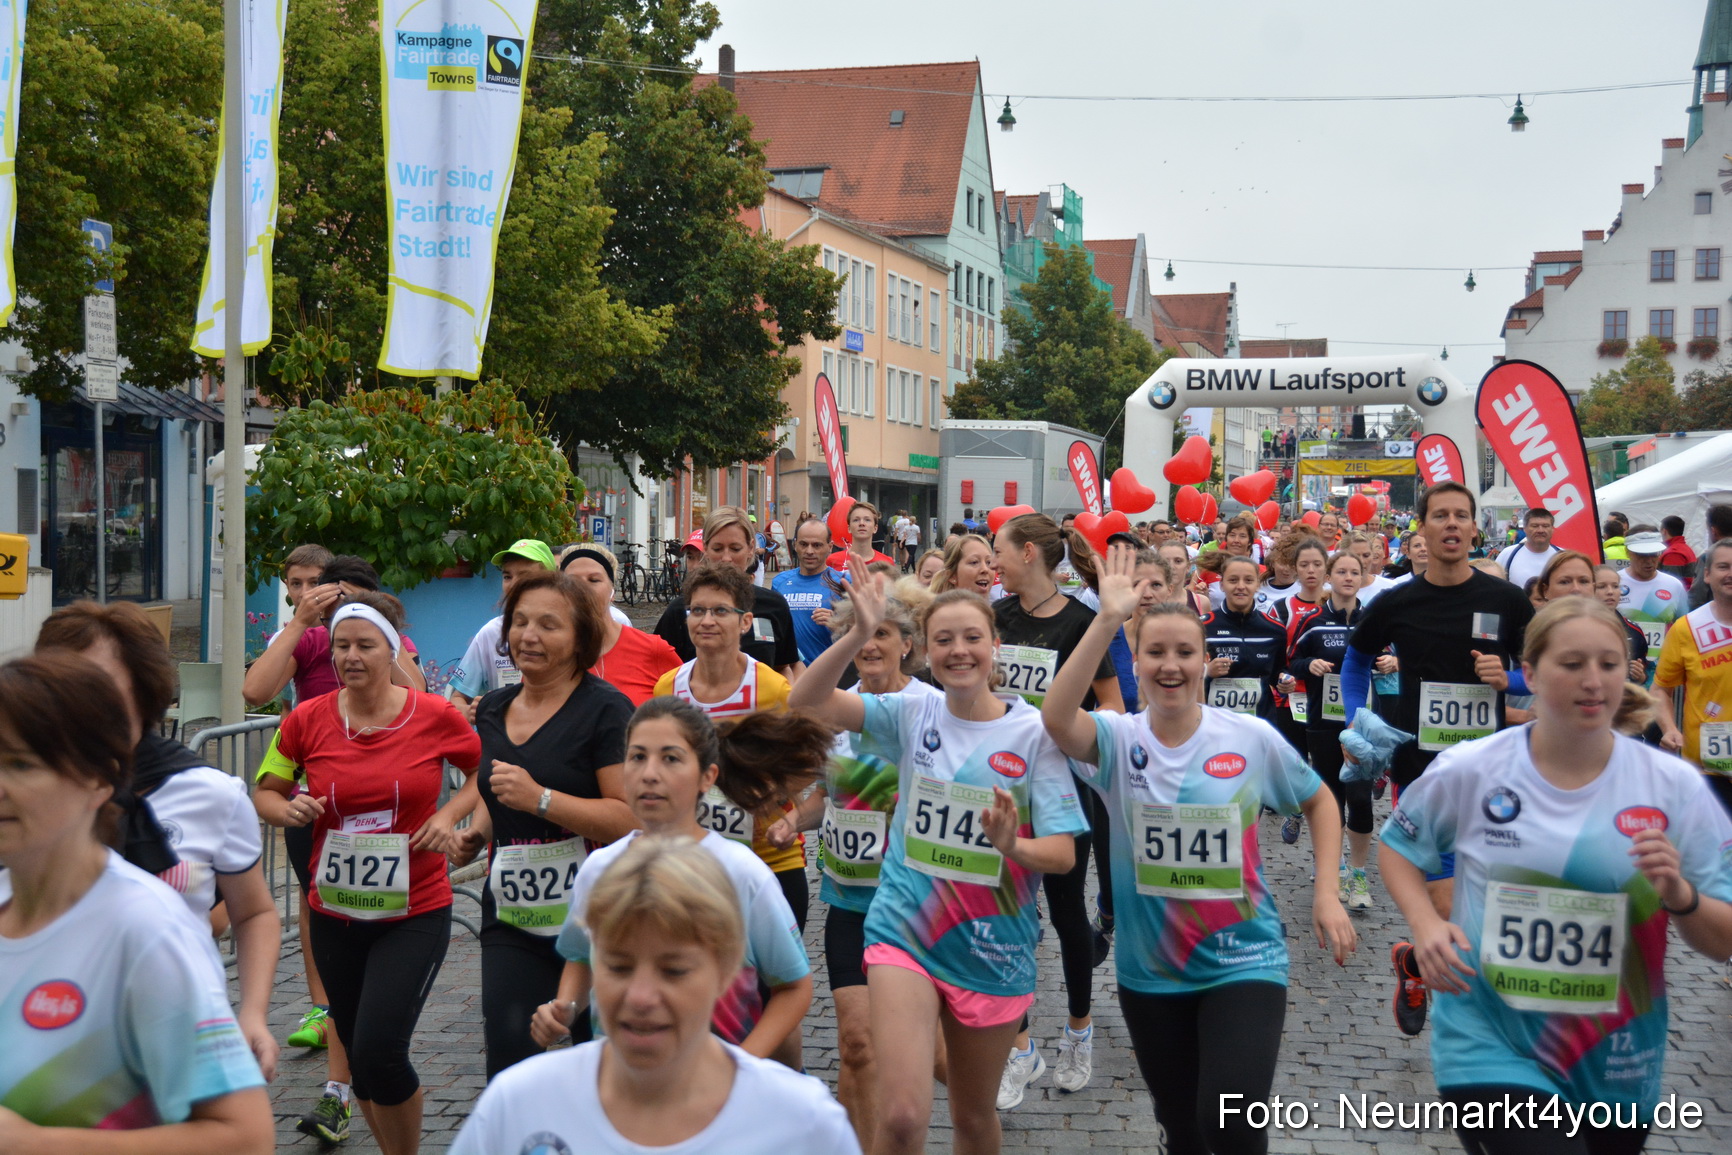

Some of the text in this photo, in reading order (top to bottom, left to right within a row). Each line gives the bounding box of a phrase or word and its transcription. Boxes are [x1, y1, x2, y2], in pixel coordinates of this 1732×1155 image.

[397, 32, 473, 48] Kampagne
[398, 47, 481, 66] Fairtrade
[429, 71, 475, 85] Towns
[487, 74, 520, 86] FAIRTRADE
[396, 162, 494, 192] Wir sind
[395, 198, 497, 228] Fairtrade
[398, 233, 471, 259] Stadt!
[90, 321, 113, 332] werktags
[1186, 367, 1406, 394] BMW Laufsport
[1491, 383, 1585, 529] REWE
[1344, 462, 1371, 472] ZIEL
[1422, 443, 1452, 488] WE
[1072, 451, 1101, 517] REWE
[594, 520, 603, 534] P
[1324, 638, 1345, 648] Götz
[1647, 632, 1660, 646] 12
[1018, 648, 1049, 662] BOCK
[997, 661, 1047, 693] 5272
[1214, 689, 1258, 709] 5044
[1456, 686, 1492, 697] BOCK
[1427, 699, 1490, 726] 5010
[1437, 730, 1478, 743] Andreas
[1707, 735, 1732, 756] 51
[993, 754, 1024, 773] Hervis
[1208, 758, 1243, 772] Hervis
[697, 801, 745, 835] 252
[836, 811, 879, 826] BOCK
[1140, 812, 1174, 821] NeuerMarkt
[1179, 807, 1231, 819] BOCK
[354, 816, 378, 828] DEHN
[1619, 814, 1664, 830] Hervis
[354, 836, 401, 848] BOCK
[825, 820, 877, 862] 5192
[1484, 828, 1521, 841] PARTL
[528, 842, 577, 860] BOCK
[1144, 825, 1228, 864] 5141
[931, 847, 964, 868] Lena
[325, 851, 401, 887] 5127
[835, 861, 857, 877] Gabi
[500, 861, 579, 903] 5324
[1169, 871, 1204, 885] Anna
[336, 891, 385, 908] Gislinde
[1496, 897, 1540, 908] NeuerMarkt
[1547, 893, 1618, 912] BOCK
[511, 910, 555, 925] Martina
[972, 920, 995, 940] 17.
[970, 936, 1021, 952] Neumarkter
[1213, 931, 1240, 948] 17.
[1497, 914, 1613, 968] 5034
[1494, 970, 1608, 998] Anna-Carina
[1609, 1031, 1635, 1052] 17.
